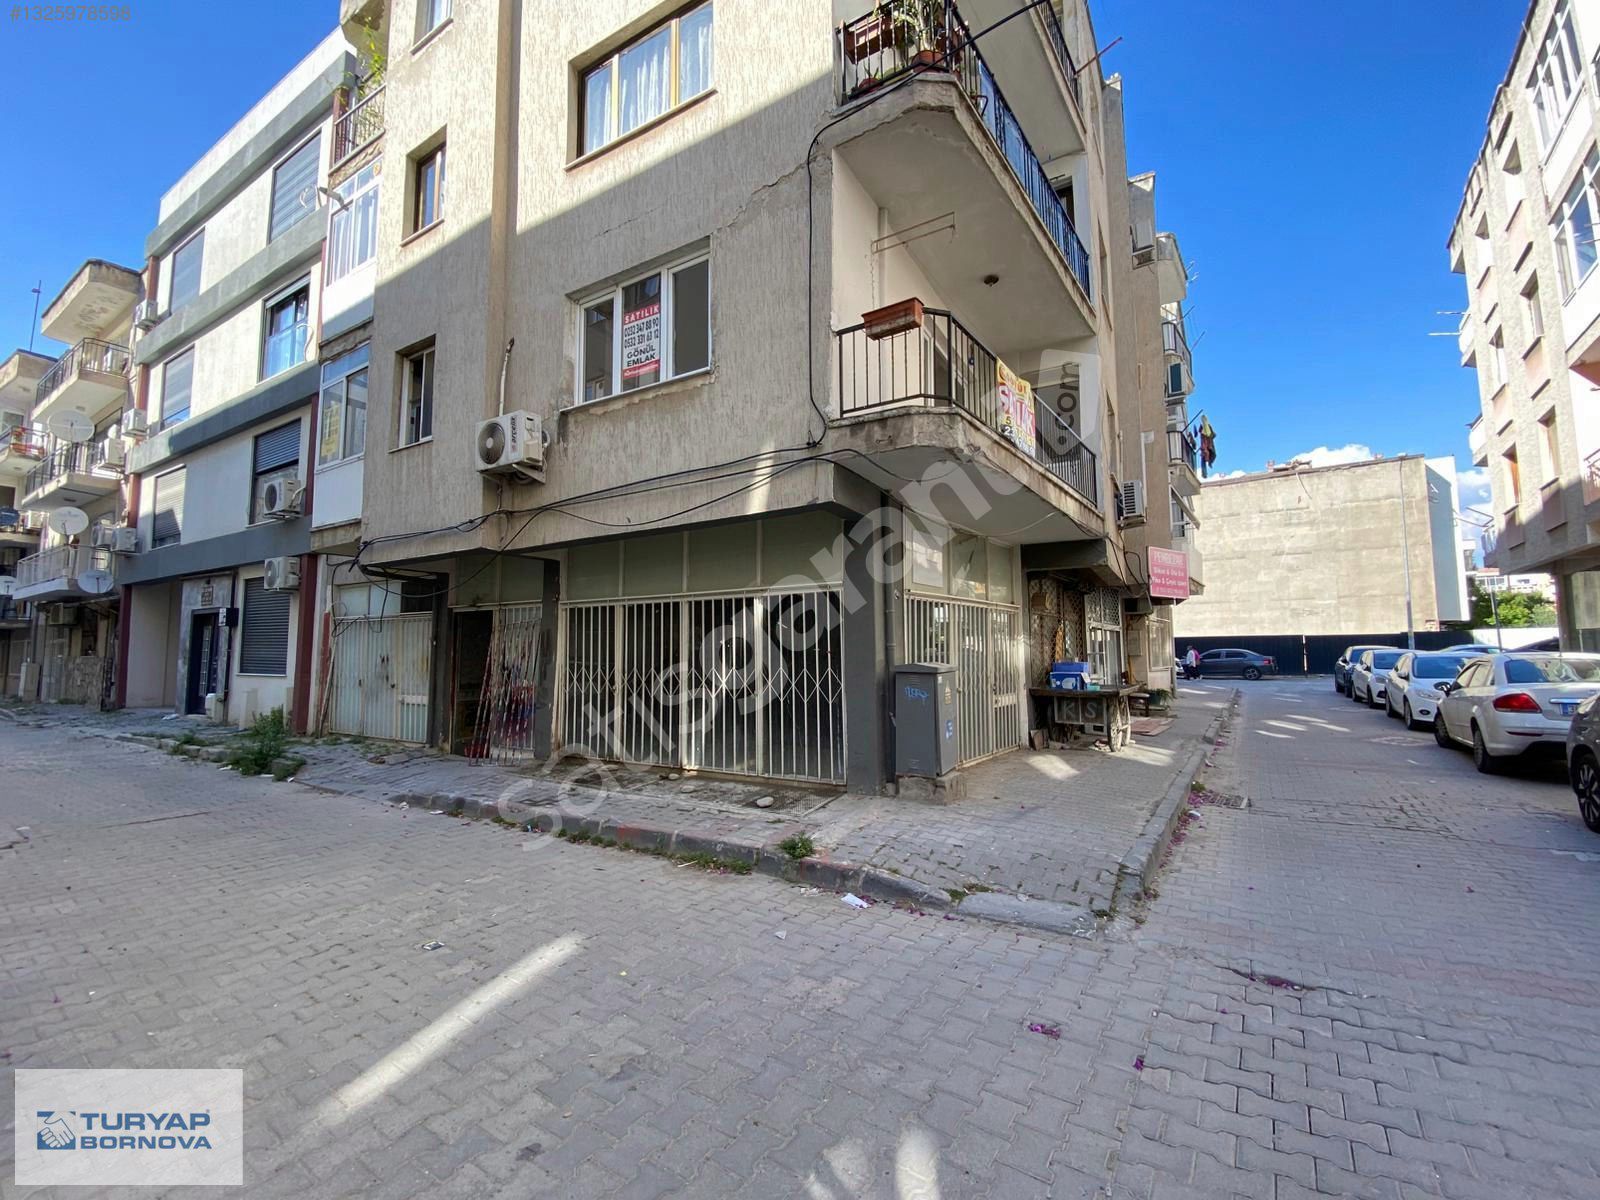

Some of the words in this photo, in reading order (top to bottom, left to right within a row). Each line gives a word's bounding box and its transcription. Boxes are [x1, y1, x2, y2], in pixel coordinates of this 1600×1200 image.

[624, 305, 659, 323] SATILIK
[627, 343, 656, 359] GÖNÜL
[627, 352, 656, 367] EMLAK
